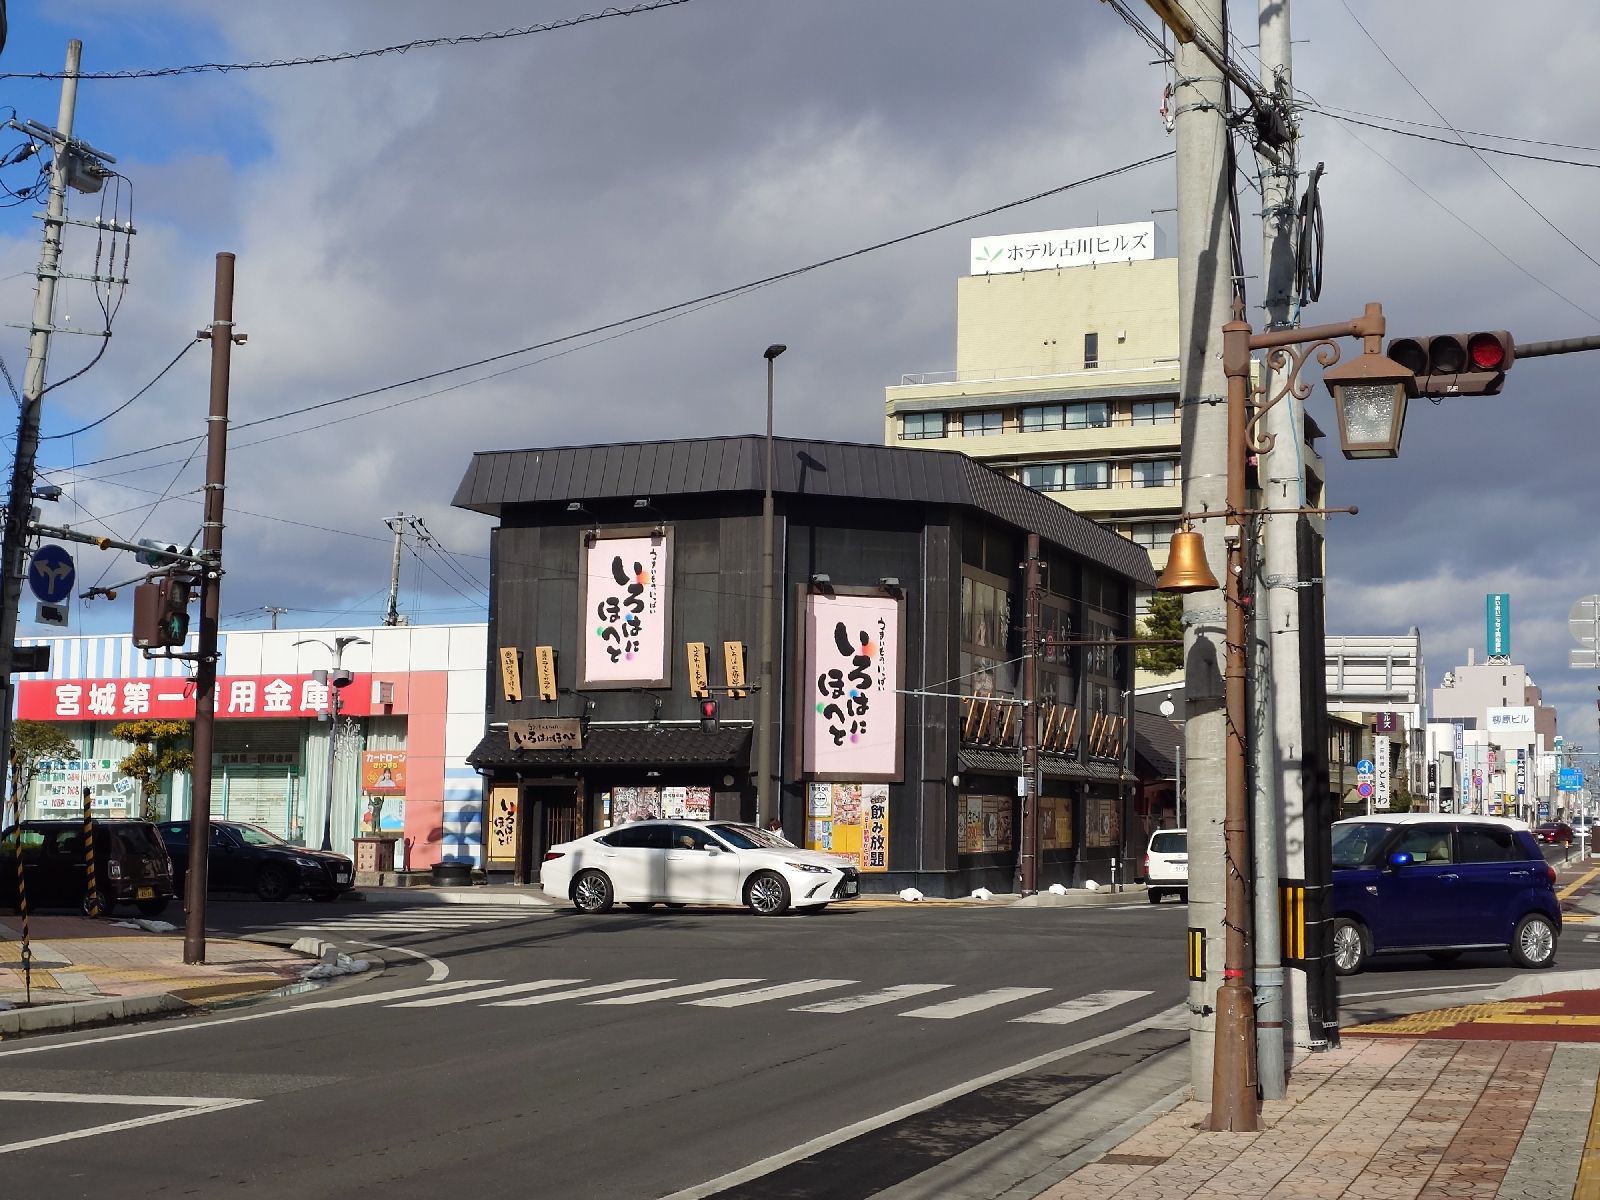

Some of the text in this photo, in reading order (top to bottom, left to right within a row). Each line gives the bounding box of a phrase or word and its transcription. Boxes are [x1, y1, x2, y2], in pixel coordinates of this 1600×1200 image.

[1007, 231, 1149, 261] ホテル古川ヒルズ
[1492, 714, 1530, 725] 柳原ビル
[513, 730, 577, 744] いろはにほへと
[366, 753, 406, 763] カードローン
[1378, 769, 1388, 805] ときわ
[870, 804, 885, 867] 飲み放題
